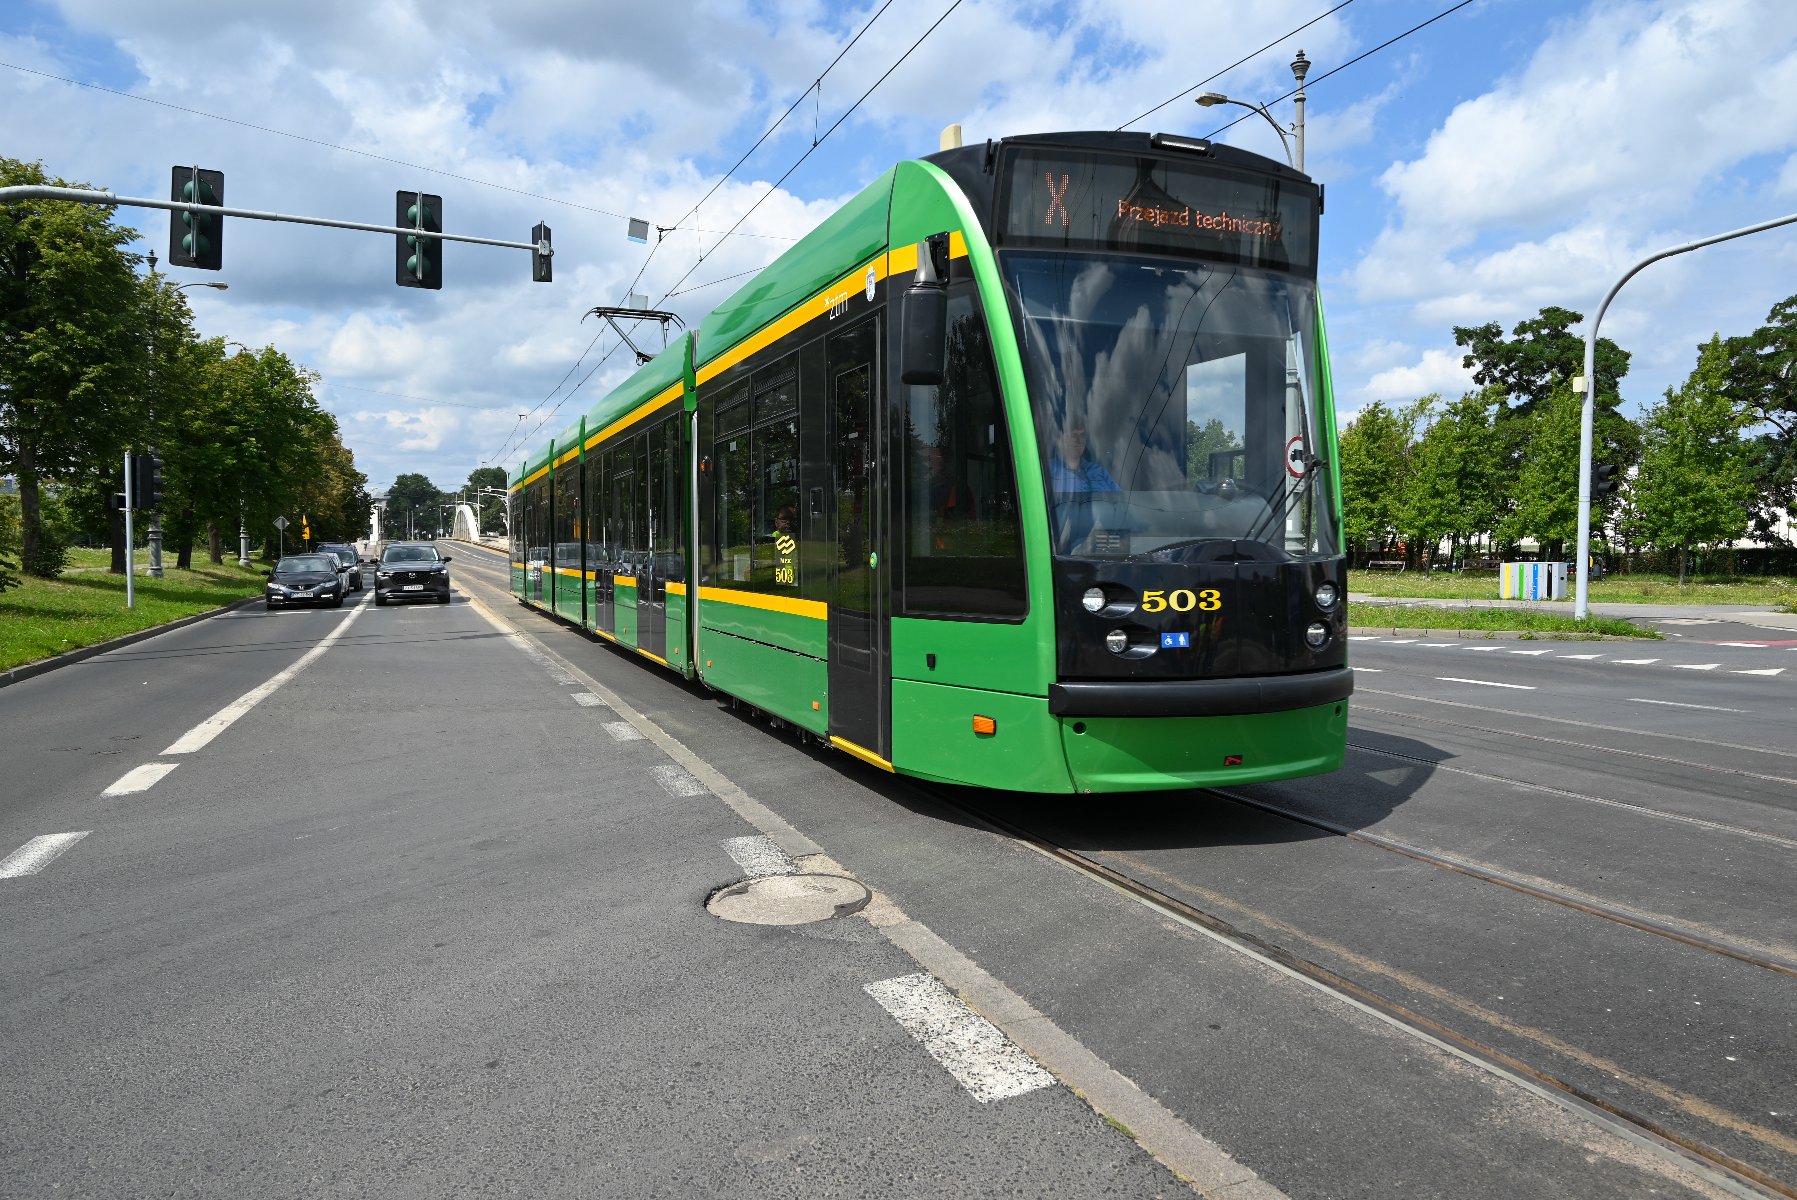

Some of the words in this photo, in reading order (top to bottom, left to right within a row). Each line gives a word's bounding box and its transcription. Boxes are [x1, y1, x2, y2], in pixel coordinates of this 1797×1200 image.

[1045, 172, 1069, 226] X
[1118, 199, 1189, 227] Przejazd
[1196, 210, 1281, 241] techniczny
[776, 568, 793, 584] 503
[1142, 589, 1221, 612] 503
